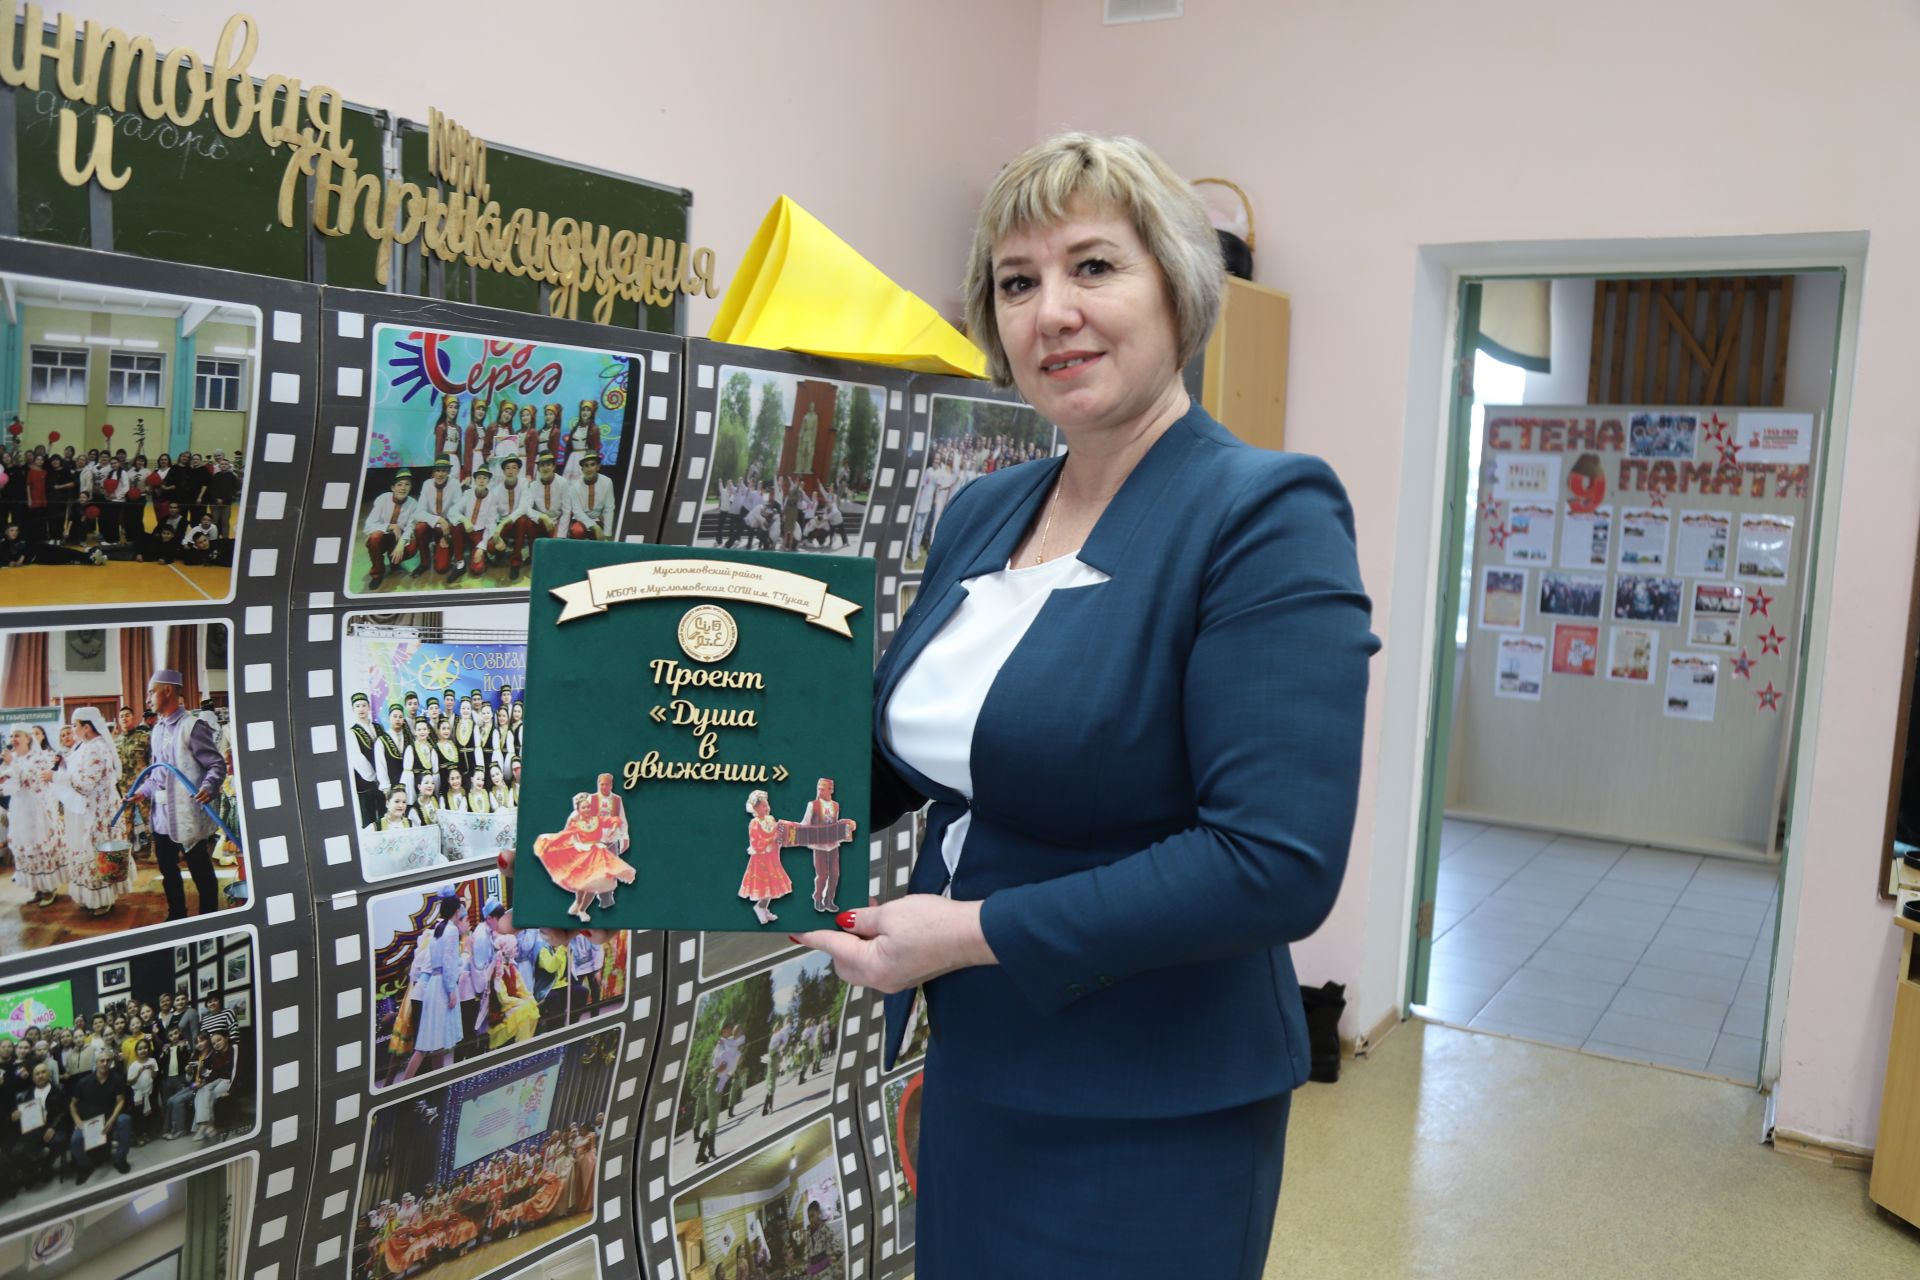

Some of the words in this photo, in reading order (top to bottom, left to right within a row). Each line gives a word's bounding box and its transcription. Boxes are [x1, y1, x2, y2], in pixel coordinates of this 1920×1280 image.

[1489, 417, 1625, 451] СТЕНА
[1618, 459, 1809, 498] ПАМЯТИ
[652, 565, 731, 577] Муслюмовский
[732, 570, 763, 581] район
[606, 586, 637, 599] МБОУ
[728, 584, 752, 595] СОШ
[650, 659, 765, 696] Проект
[699, 731, 719, 760] в
